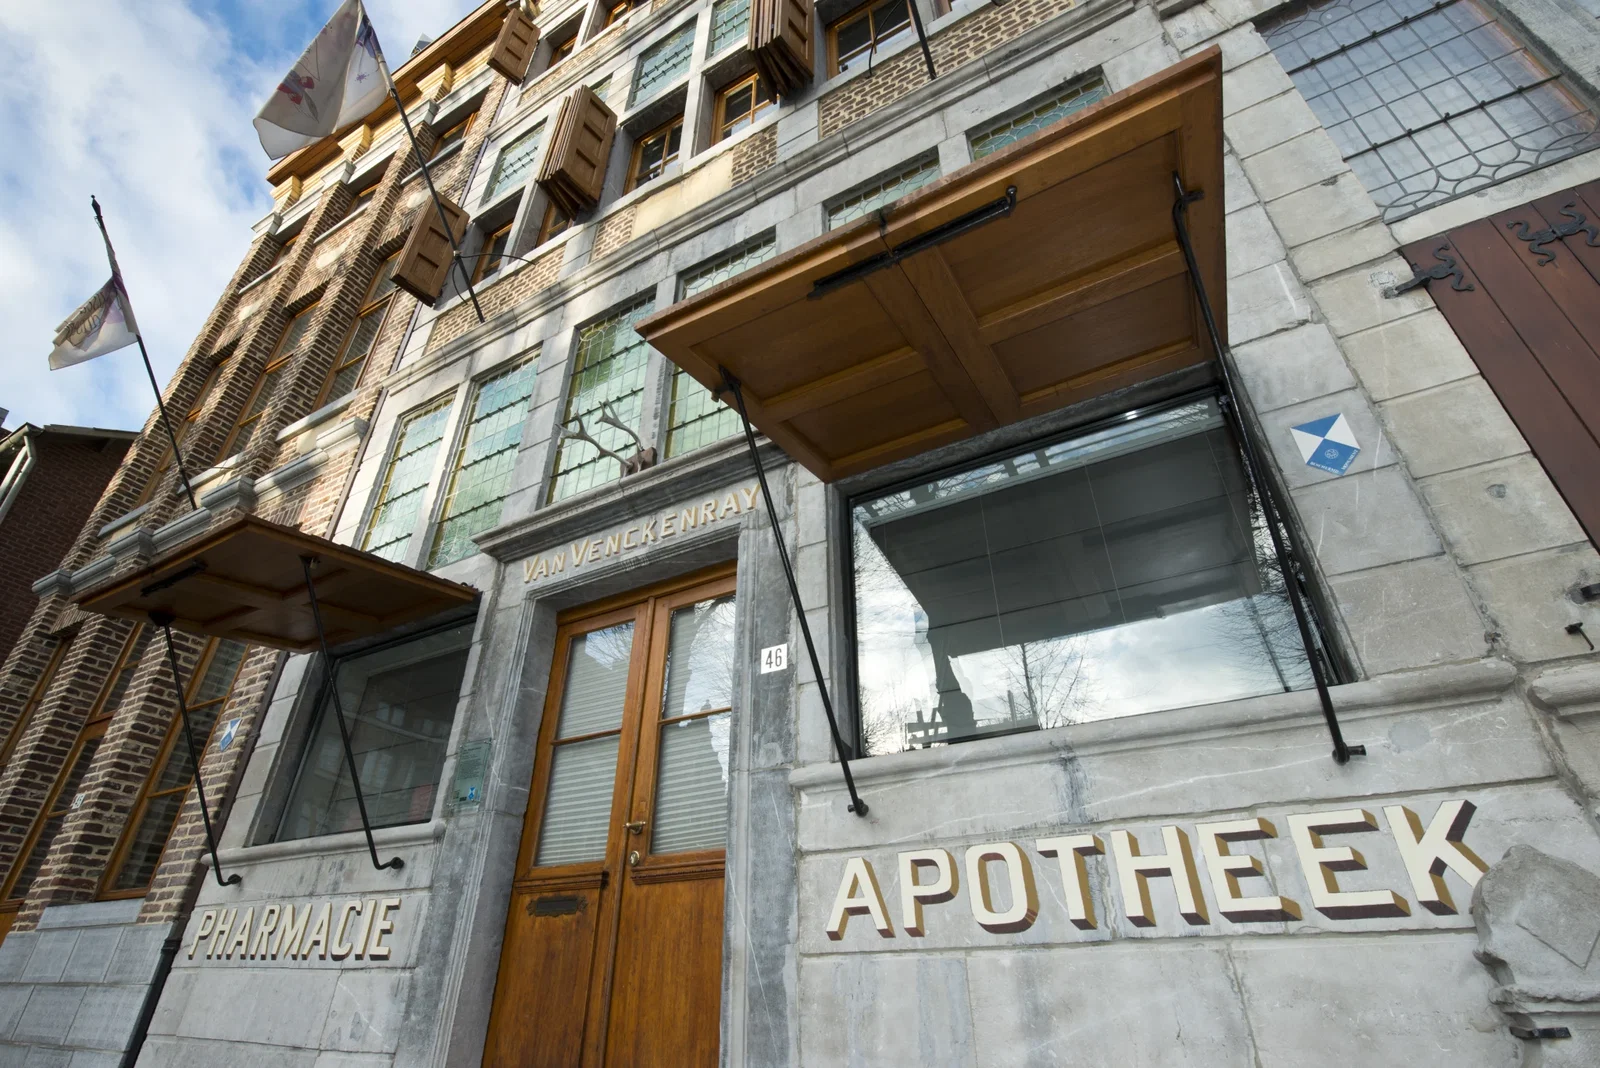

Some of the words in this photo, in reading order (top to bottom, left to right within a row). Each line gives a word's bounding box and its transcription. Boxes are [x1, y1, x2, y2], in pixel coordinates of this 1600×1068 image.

[523, 552, 567, 584] VAN
[571, 482, 761, 566] VENCKENRAY
[765, 648, 783, 669] 46
[826, 799, 1490, 942] APOTHEEK
[188, 898, 401, 962] PHARMACIE
